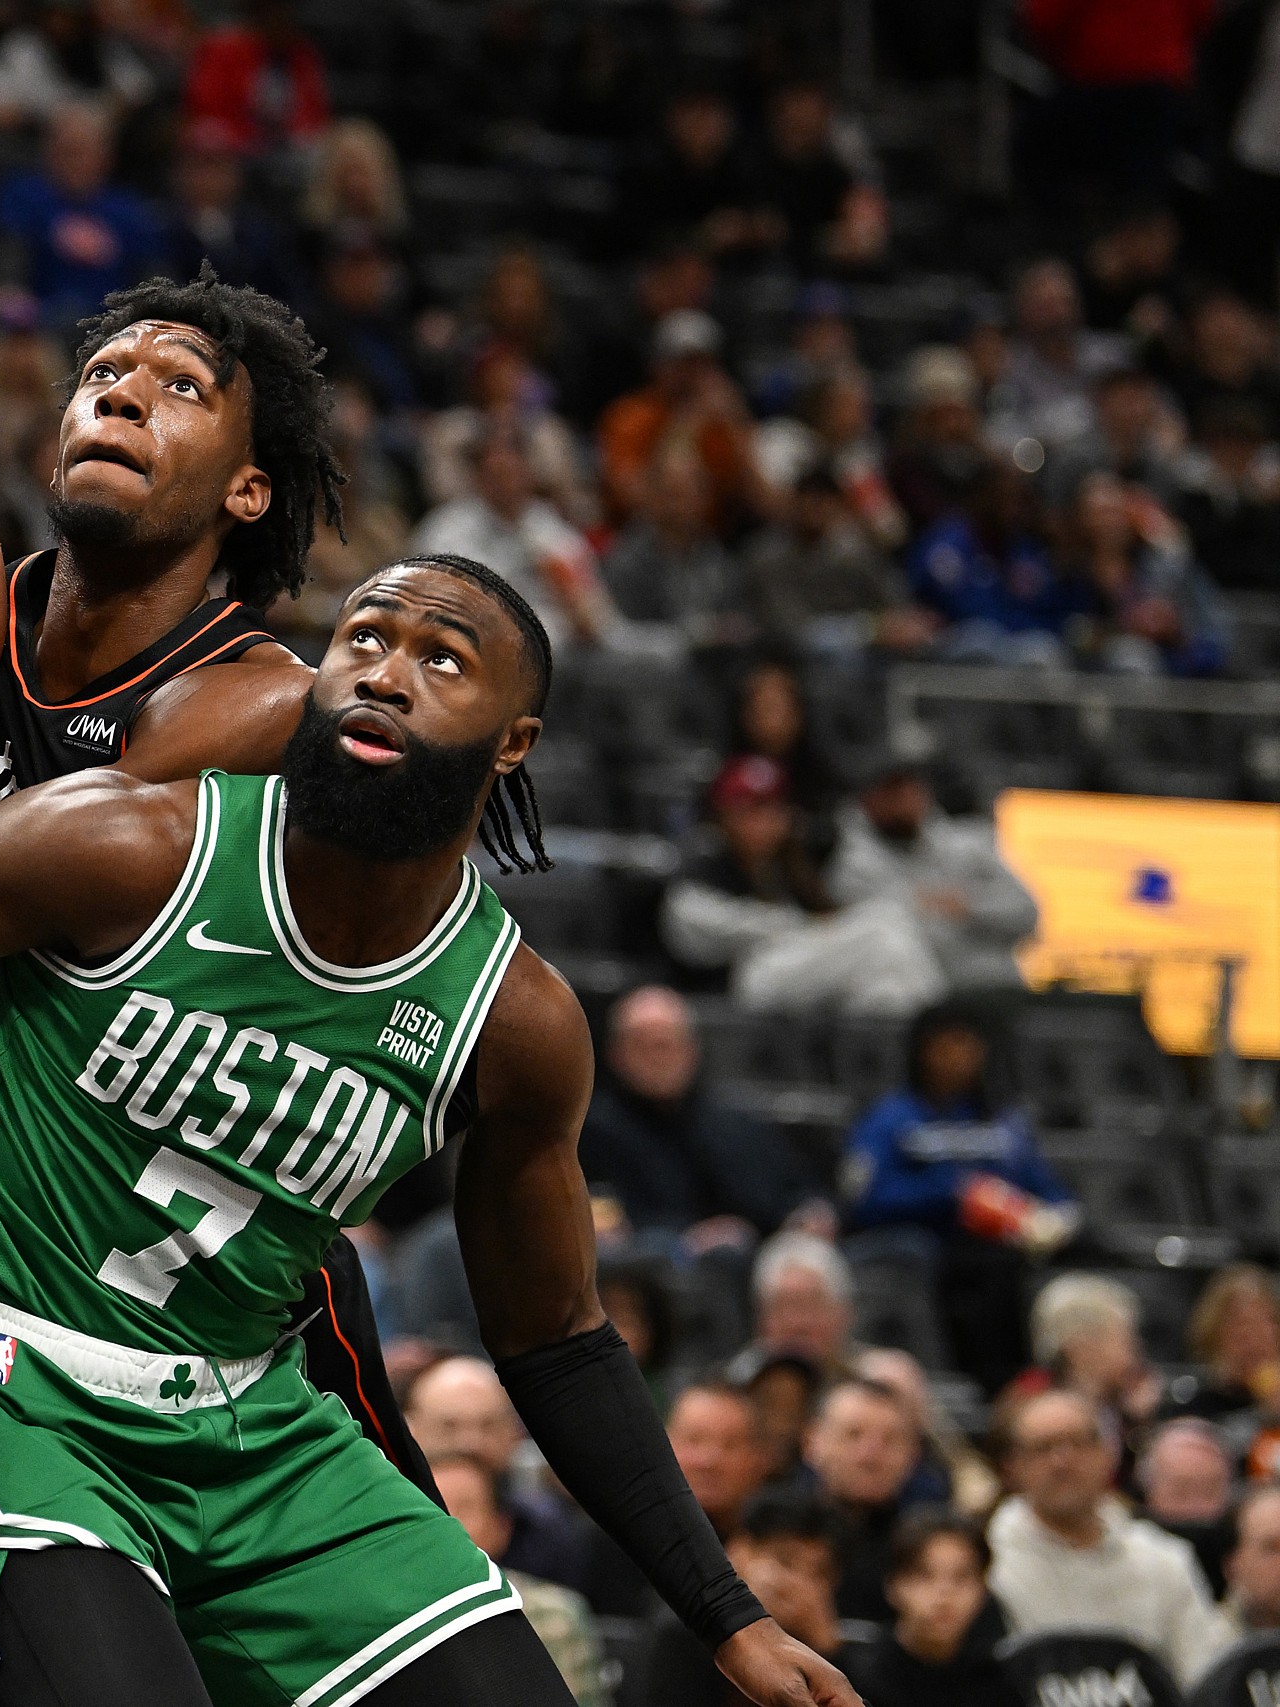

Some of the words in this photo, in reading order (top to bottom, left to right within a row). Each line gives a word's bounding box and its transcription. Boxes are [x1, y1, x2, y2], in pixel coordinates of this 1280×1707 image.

[66, 714, 117, 746] UWM
[376, 1026, 435, 1069] PRINT
[388, 999, 445, 1050] VISTA
[75, 990, 411, 1221] BOSTON
[96, 1145, 263, 1310] 7
